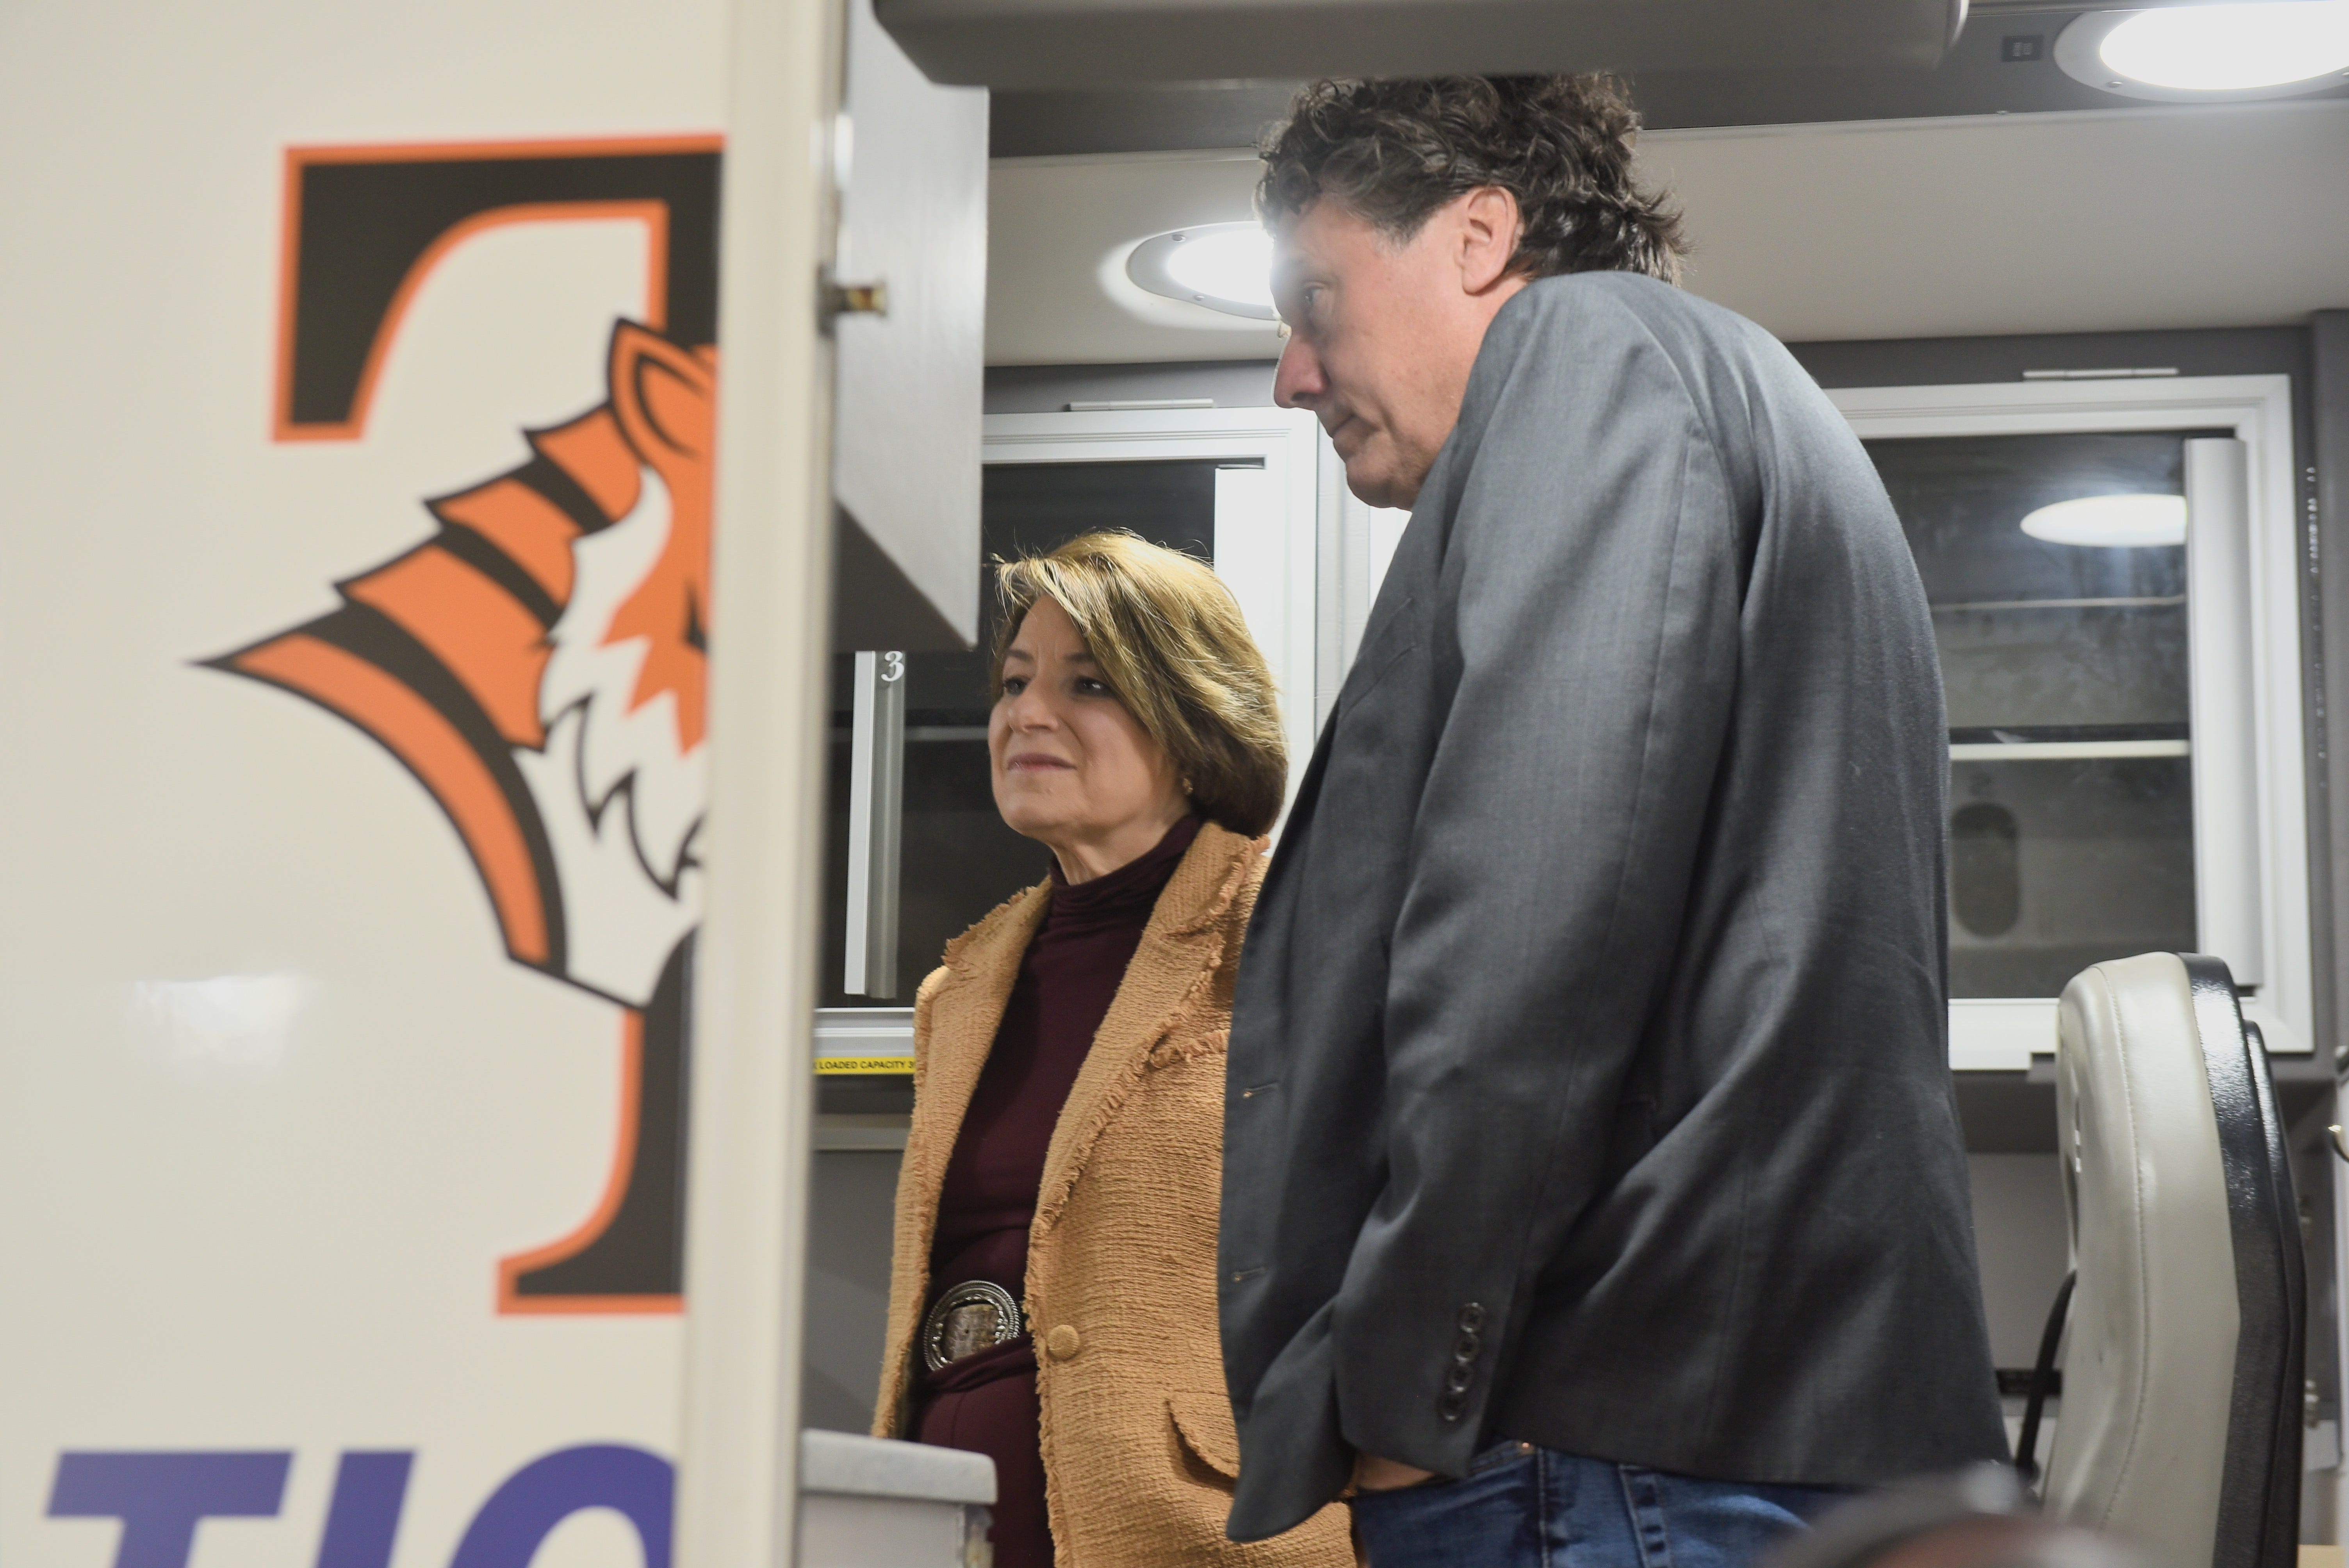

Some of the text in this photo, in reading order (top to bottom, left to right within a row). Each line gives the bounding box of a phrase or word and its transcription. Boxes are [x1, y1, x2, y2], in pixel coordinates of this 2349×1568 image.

[880, 650, 905, 682] 3
[820, 1061, 857, 1069] LOADED
[860, 1060, 904, 1069] CAPACITY
